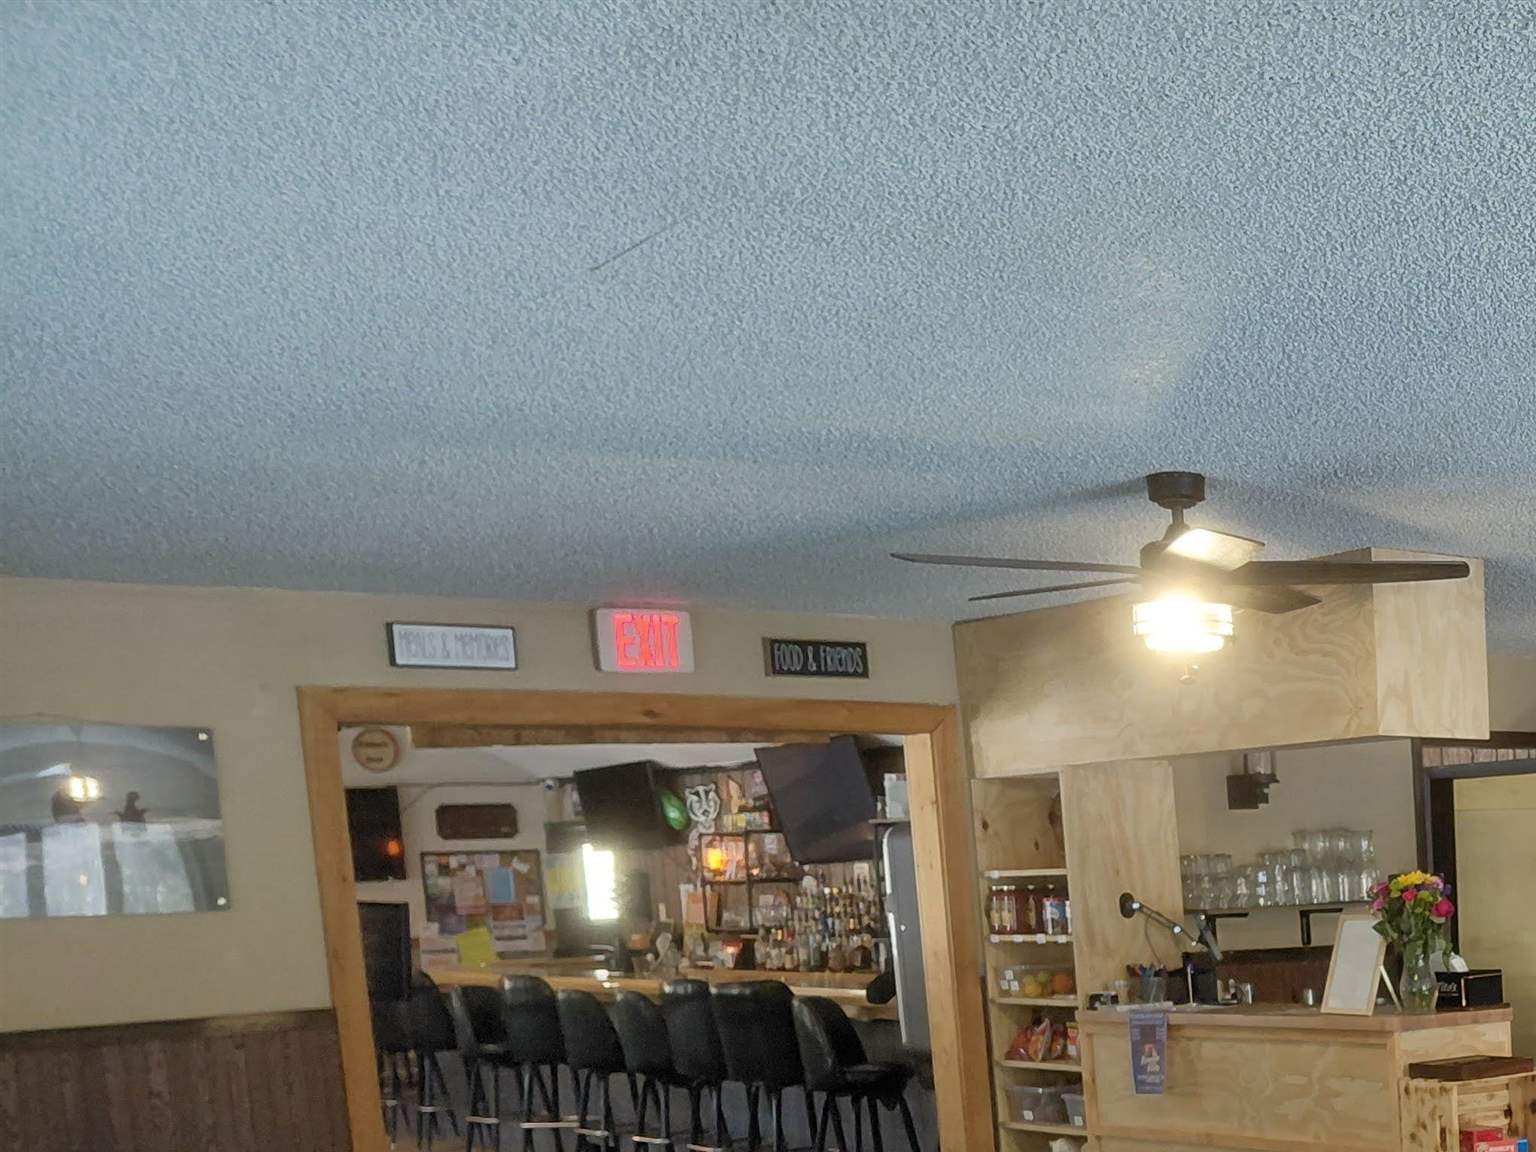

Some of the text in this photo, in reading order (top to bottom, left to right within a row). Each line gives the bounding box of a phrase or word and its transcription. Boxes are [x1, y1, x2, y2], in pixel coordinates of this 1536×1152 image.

[441, 632, 450, 659] &
[614, 614, 680, 669] EXIT
[774, 643, 864, 673] FOOD & FRIENDS
